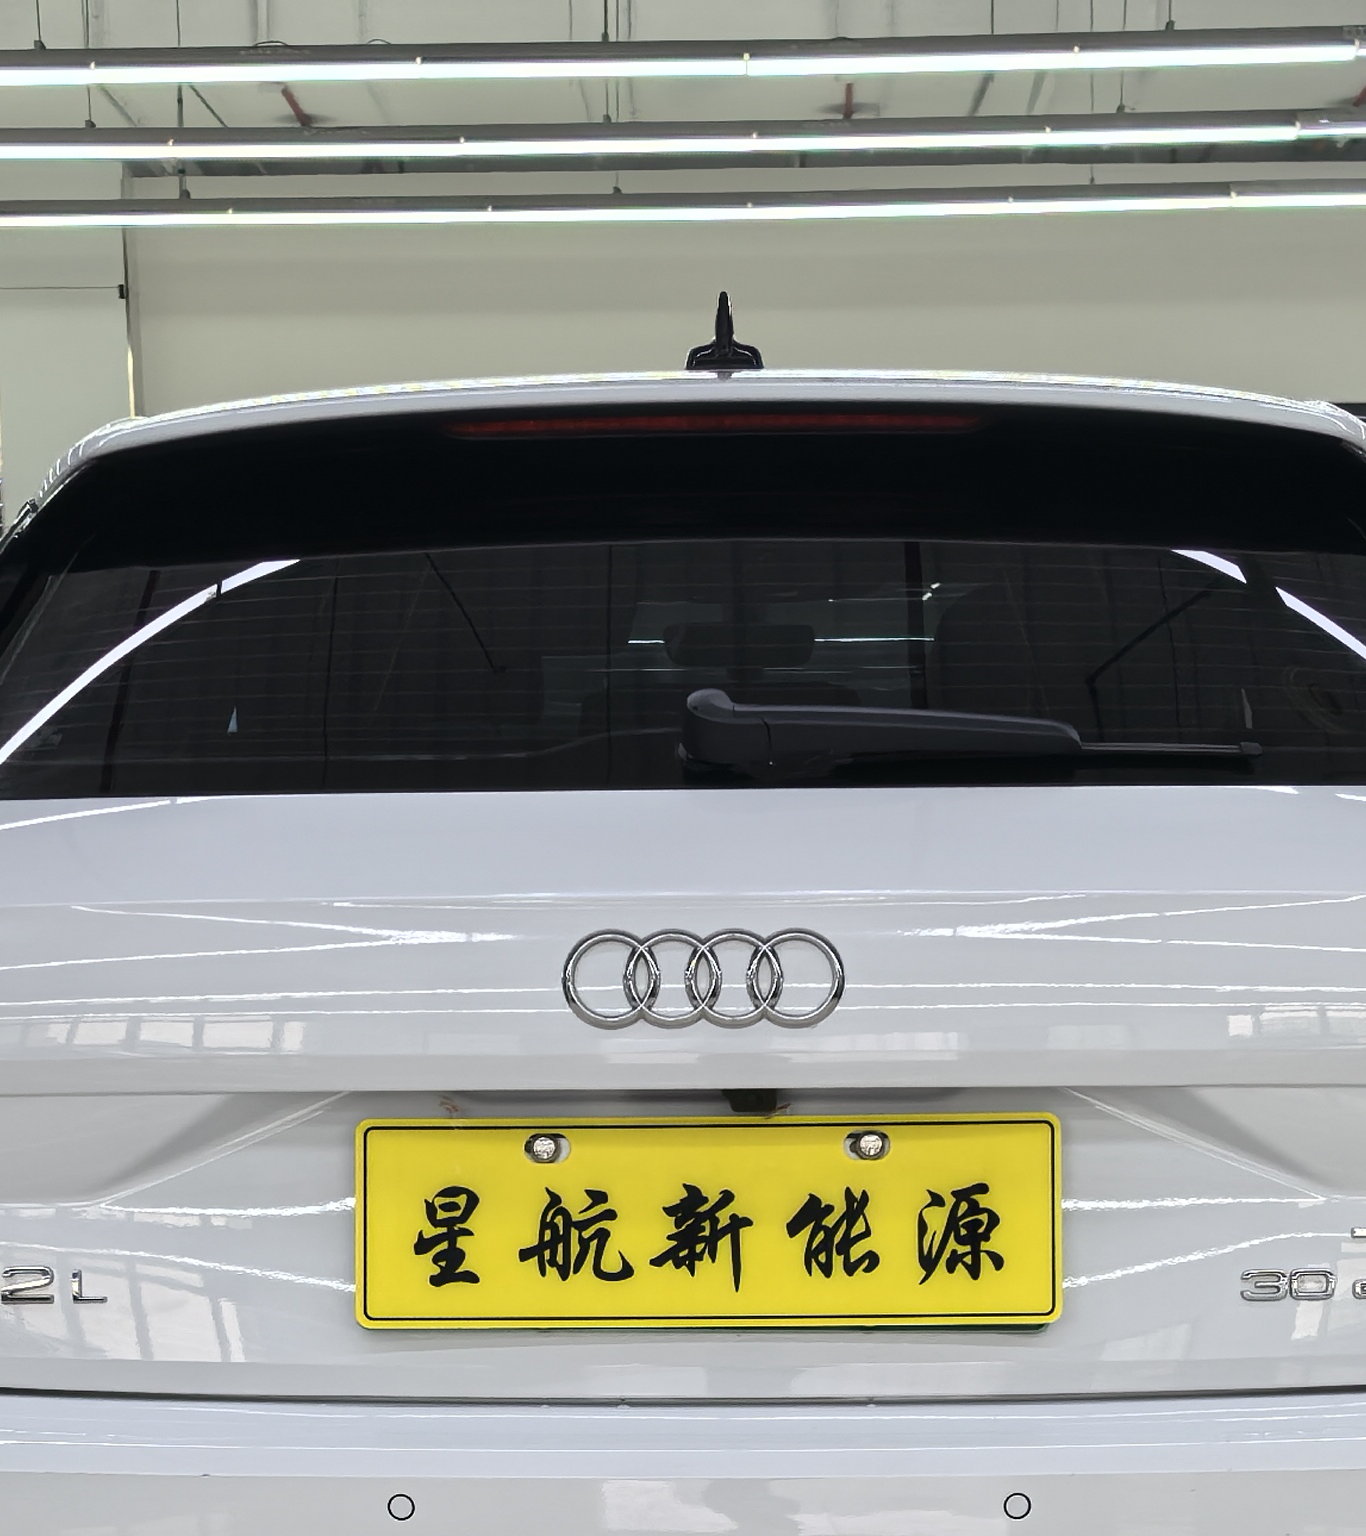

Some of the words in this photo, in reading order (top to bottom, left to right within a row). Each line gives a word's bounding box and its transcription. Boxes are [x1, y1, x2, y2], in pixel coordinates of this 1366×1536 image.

[413, 1181, 1006, 1294] 星航新能源
[1240, 1268, 1337, 1301] 30
